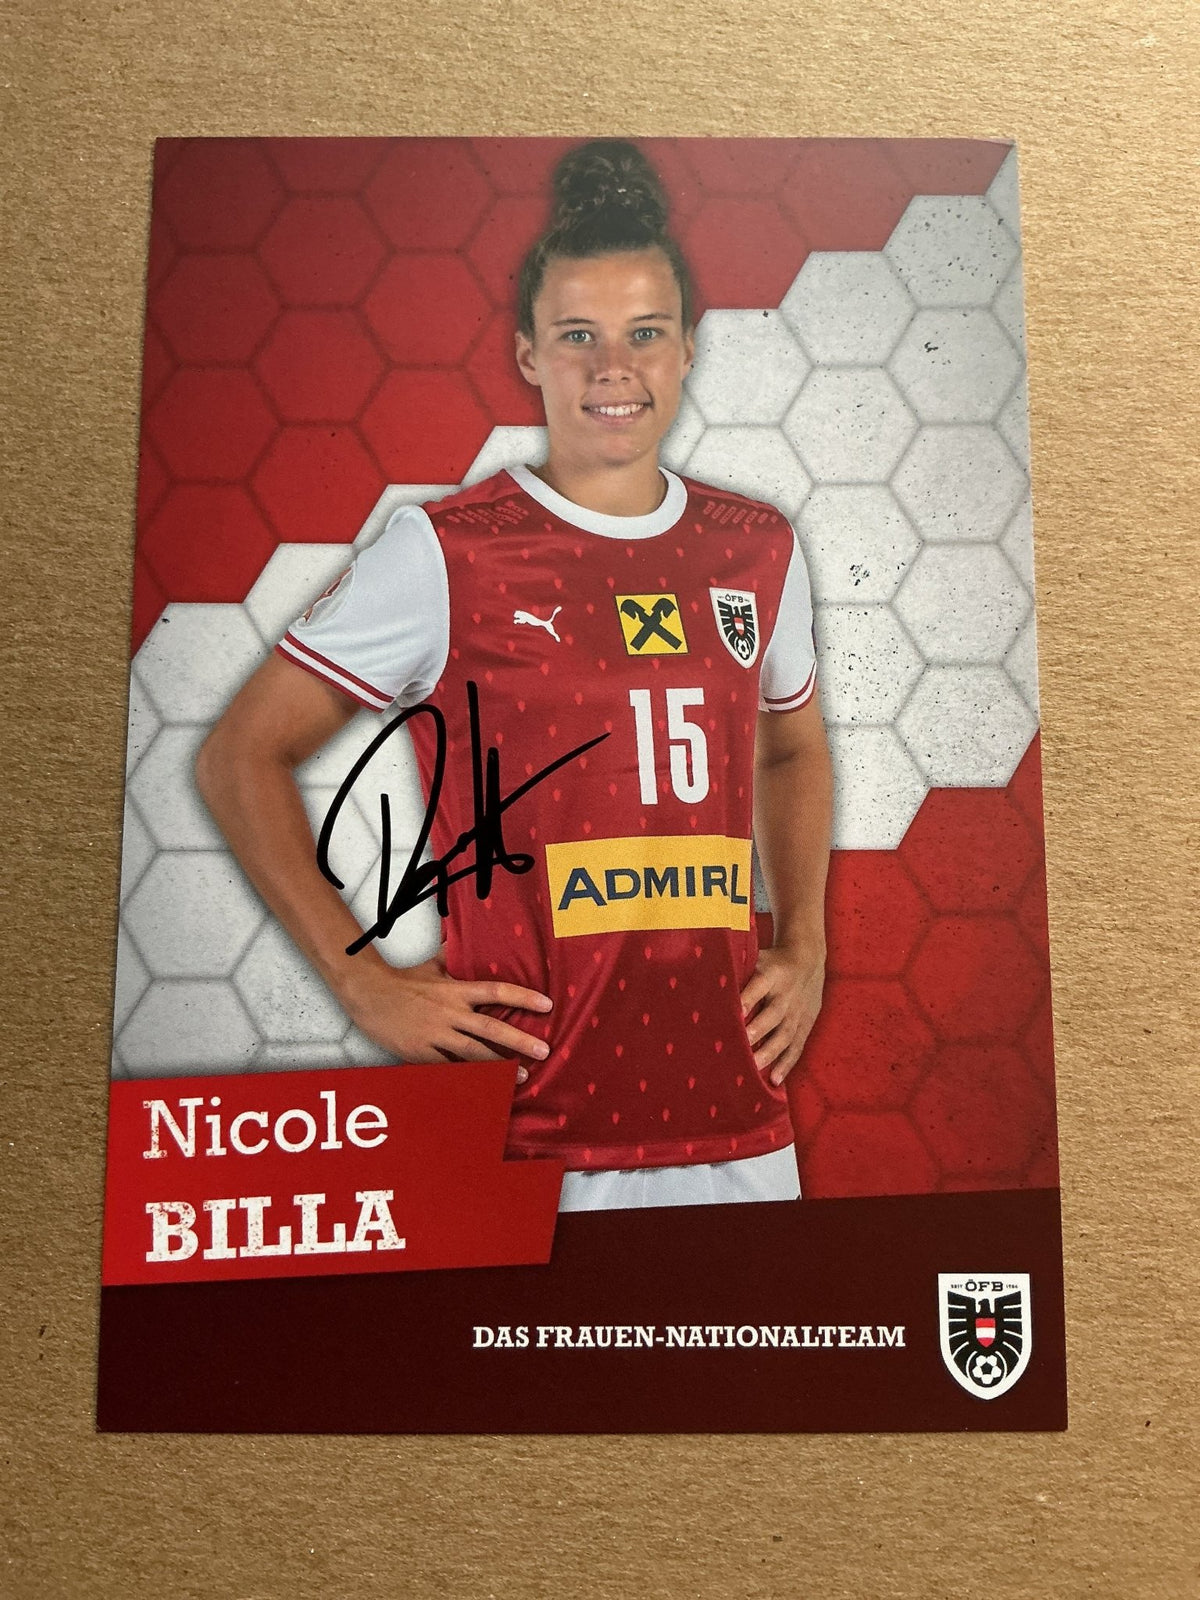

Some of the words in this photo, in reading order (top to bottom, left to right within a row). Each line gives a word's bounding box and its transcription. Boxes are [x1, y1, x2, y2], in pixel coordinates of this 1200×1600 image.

[725, 594, 743, 603] ÖFB
[630, 688, 710, 805] 15
[142, 1090, 389, 1160] Nicole
[145, 1190, 406, 1263] BILLA
[965, 1279, 1003, 1291] ÖFB
[472, 1326, 529, 1348] DAS
[536, 1325, 906, 1348] FRAUEN-NATIONALTEAM
